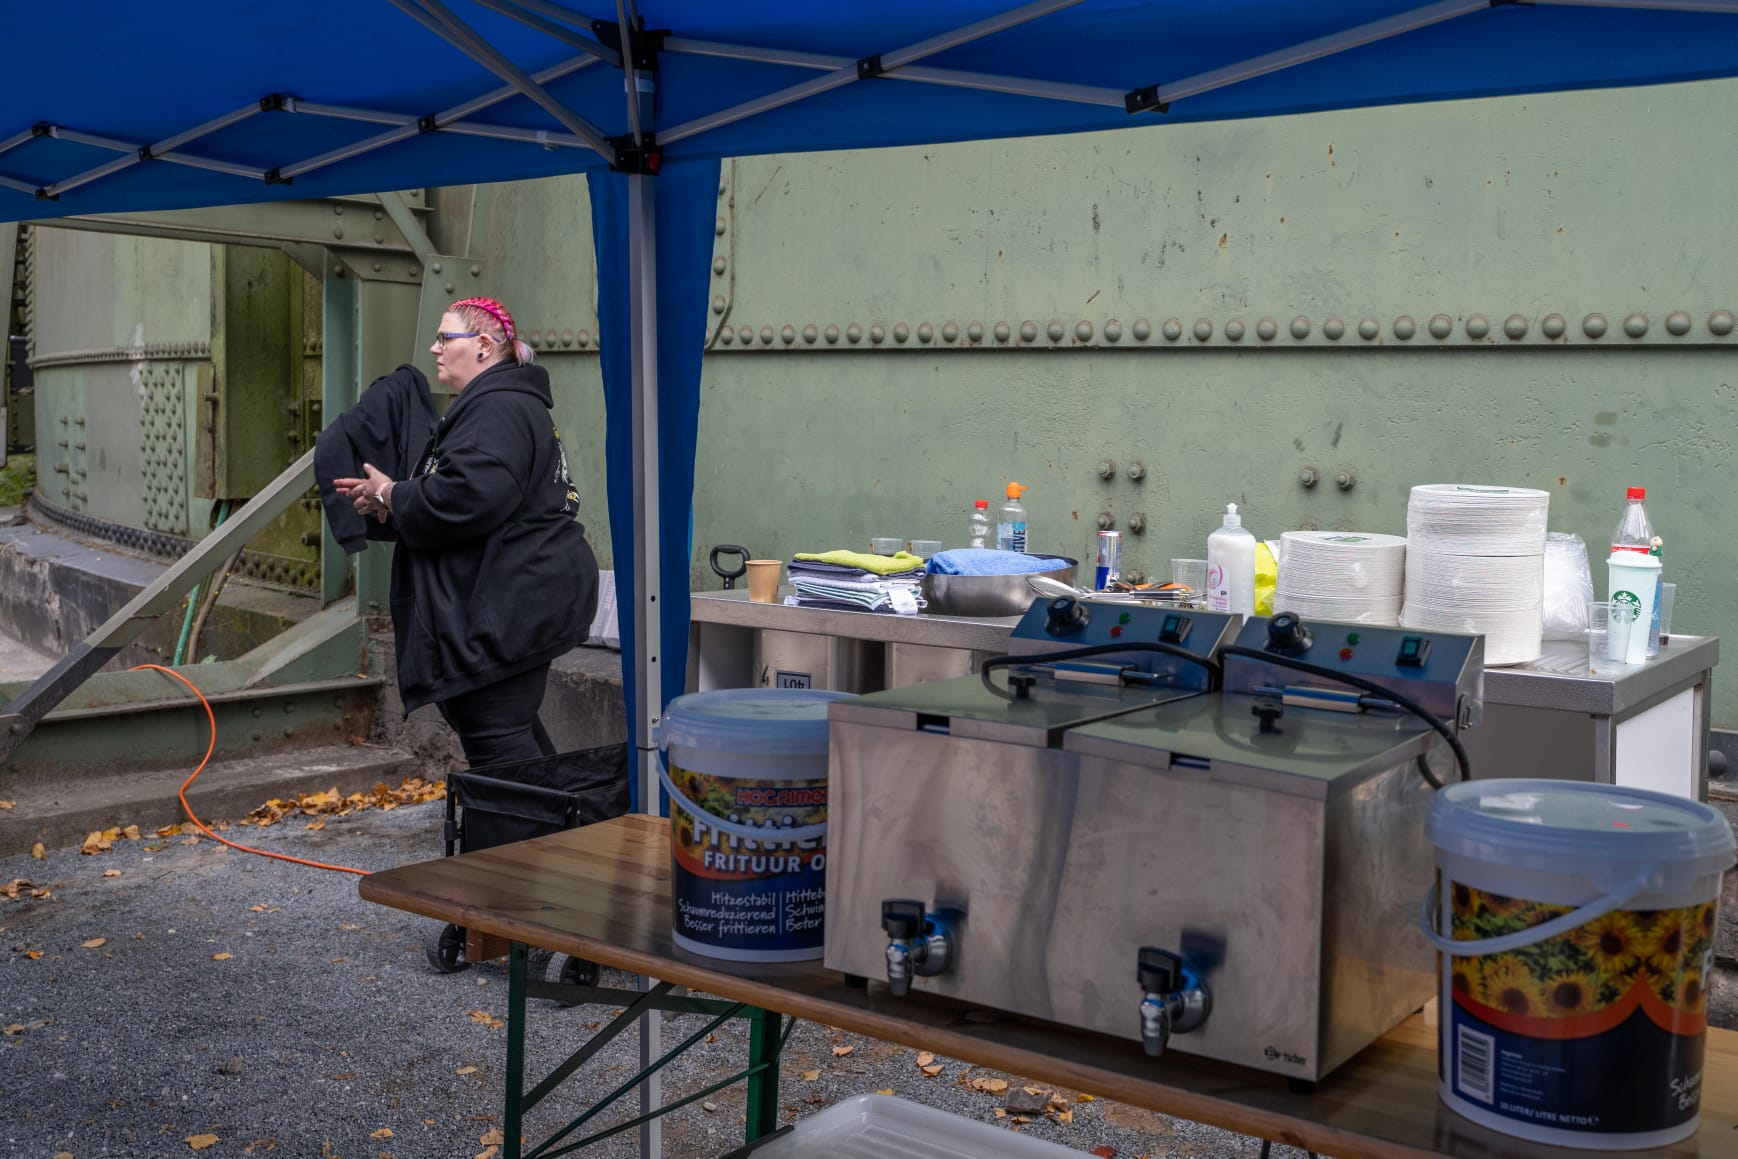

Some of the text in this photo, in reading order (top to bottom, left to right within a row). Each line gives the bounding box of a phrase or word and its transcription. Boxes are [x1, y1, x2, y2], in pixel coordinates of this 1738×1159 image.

[704, 850, 801, 873] FRITUUR
[678, 898, 776, 920] Schaumreduzierend
[711, 891, 776, 907] Hitzestabil
[683, 914, 776, 938] Besser frittieren
[785, 916, 822, 932] Beter
